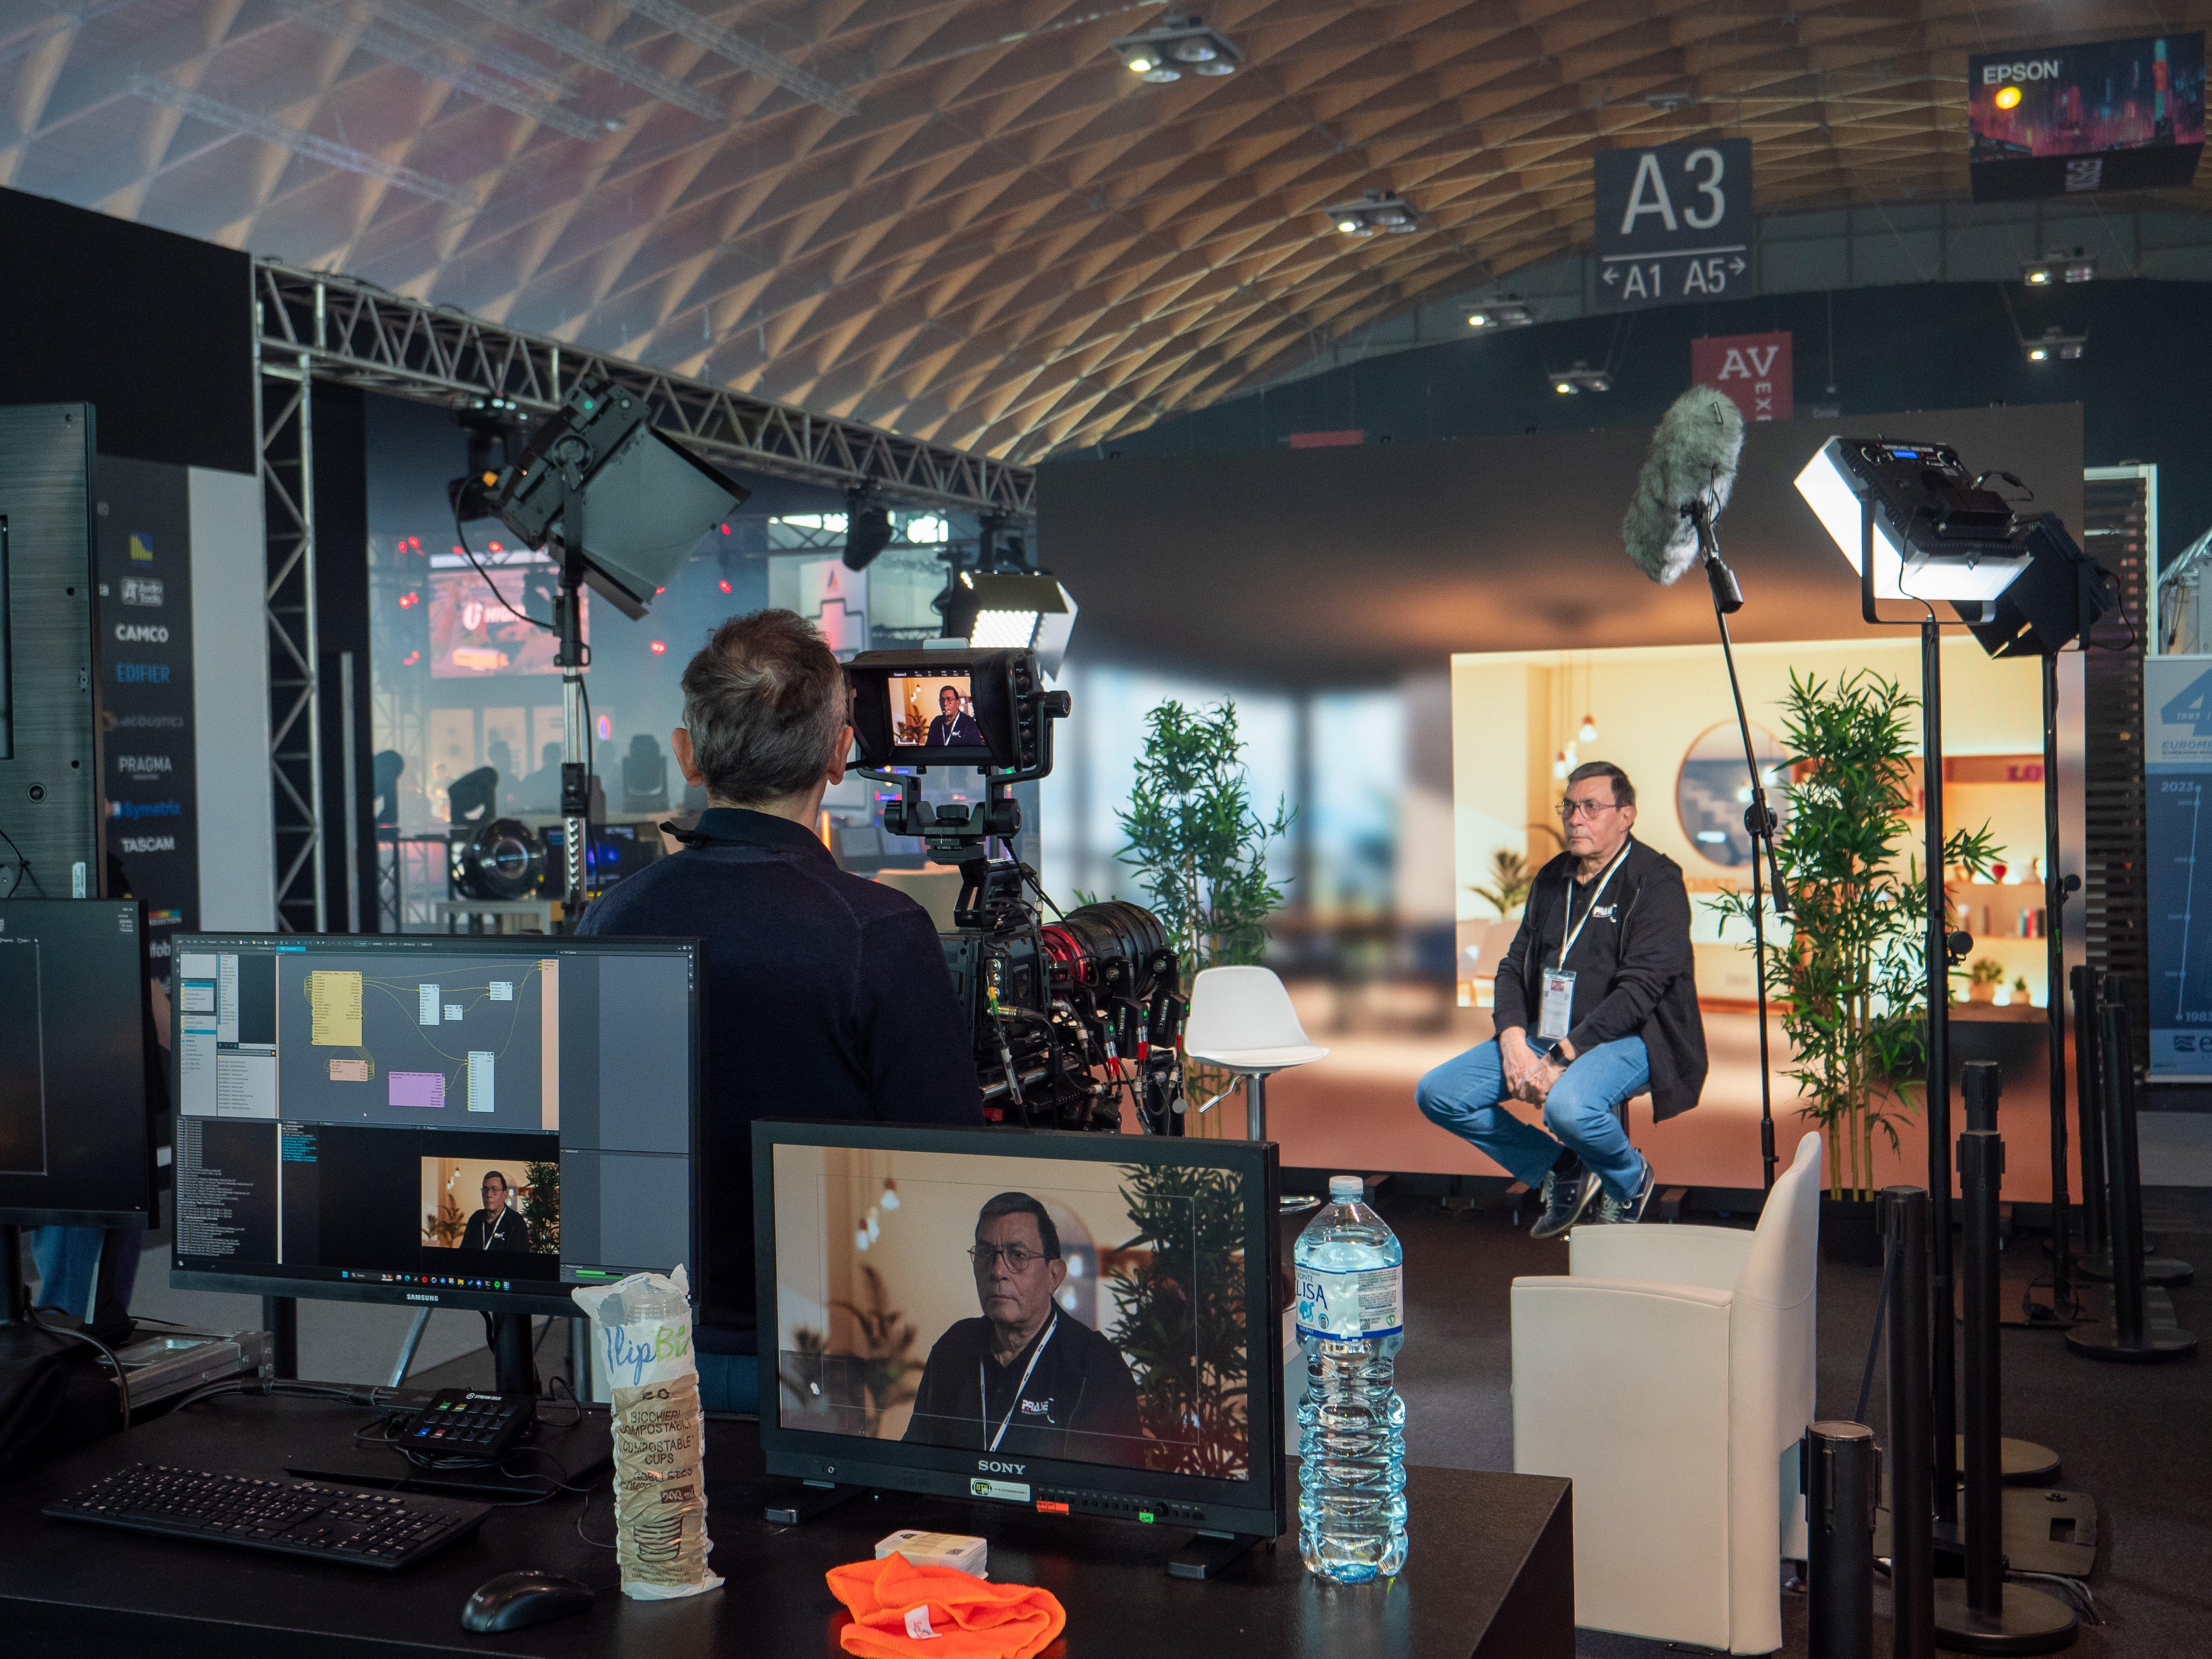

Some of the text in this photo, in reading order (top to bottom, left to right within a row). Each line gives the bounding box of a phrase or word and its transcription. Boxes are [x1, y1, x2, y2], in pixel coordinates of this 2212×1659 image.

[1983, 59, 2059, 86] EPSON
[1620, 147, 1726, 235] A3
[1623, 257, 1726, 300] A1 A5
[1718, 345, 1780, 380] AV
[115, 624, 170, 643] CAMCO
[116, 664, 170, 683] EDIFIER
[118, 755, 173, 772] PRAGMA
[121, 836, 176, 853] TASCAM
[1297, 1272, 1314, 1283] FONTE
[406, 1293, 439, 1301] SAMSUNG
[630, 1410, 681, 1424] BICCHIERI
[645, 1453, 674, 1465] CUPS
[978, 1460, 1026, 1475] SONY
